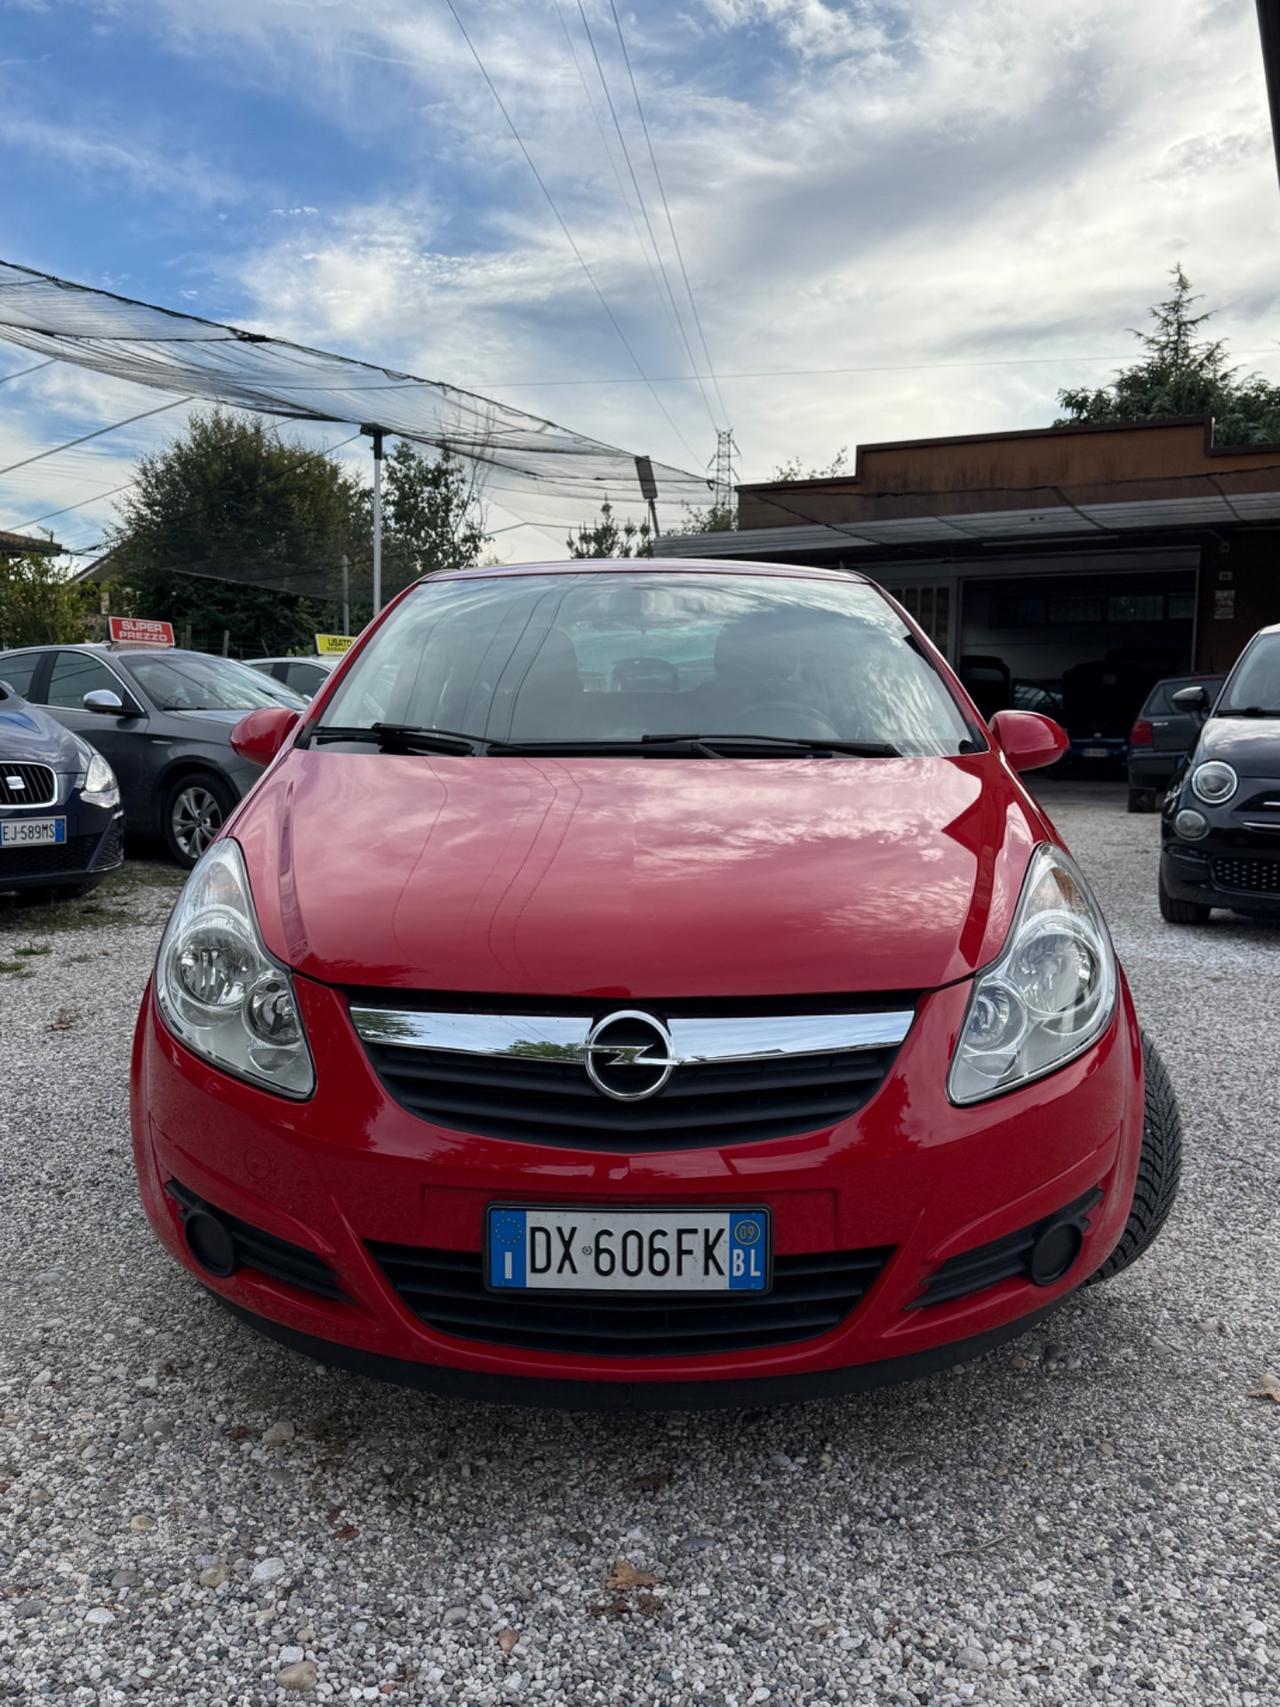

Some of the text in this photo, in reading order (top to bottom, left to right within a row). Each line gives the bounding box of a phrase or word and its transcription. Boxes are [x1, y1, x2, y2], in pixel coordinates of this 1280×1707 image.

[119, 630, 167, 641] PREZZO
[121, 620, 162, 632] SUPER
[504, 1251, 513, 1280] I
[732, 1248, 761, 1277] BL
